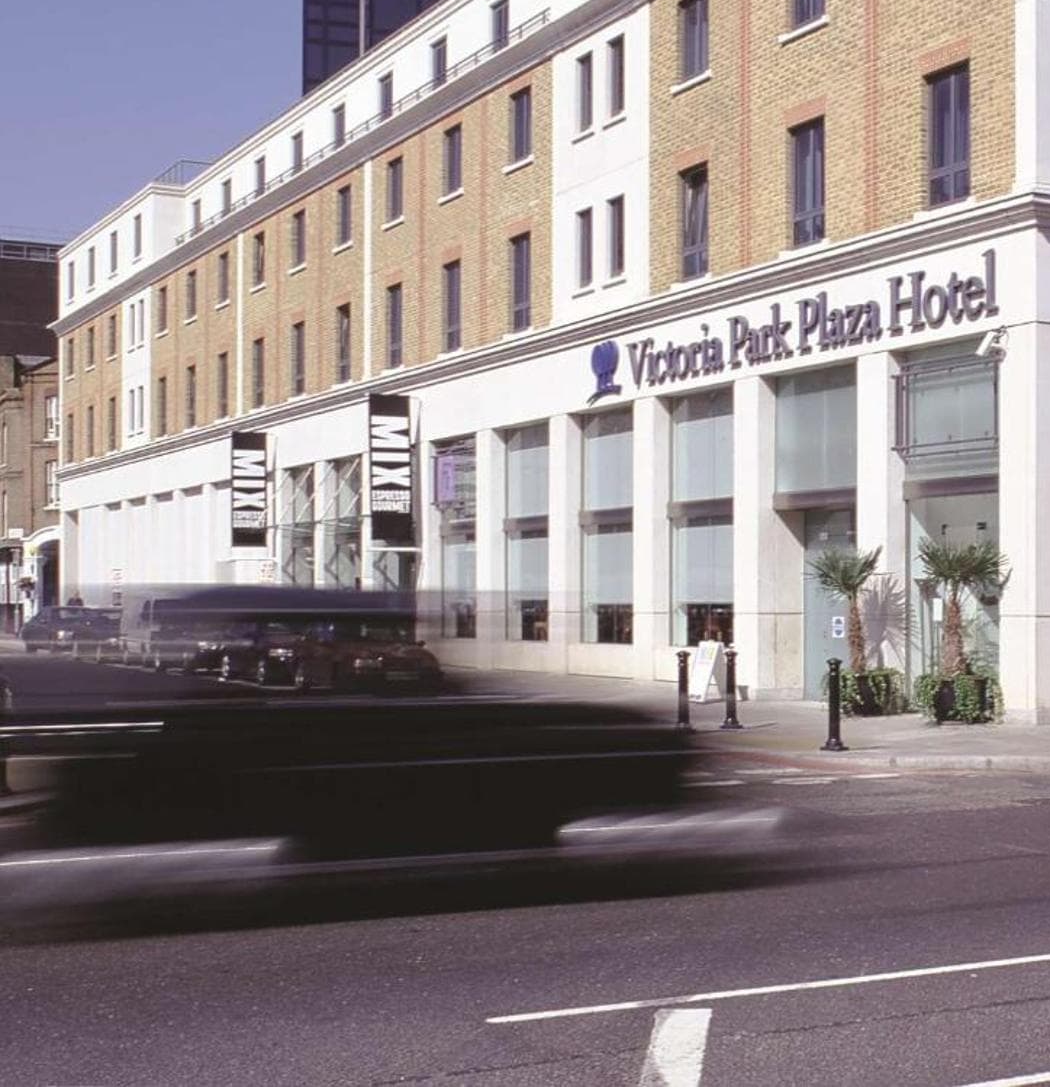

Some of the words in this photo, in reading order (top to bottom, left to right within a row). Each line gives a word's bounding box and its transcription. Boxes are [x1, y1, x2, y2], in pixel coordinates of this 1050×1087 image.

[627, 323, 725, 389] Victoria
[727, 302, 798, 367] Park
[796, 291, 884, 350] Plaza
[887, 248, 999, 336] Hotel
[233, 450, 266, 509] MIX
[371, 415, 411, 487] MIX
